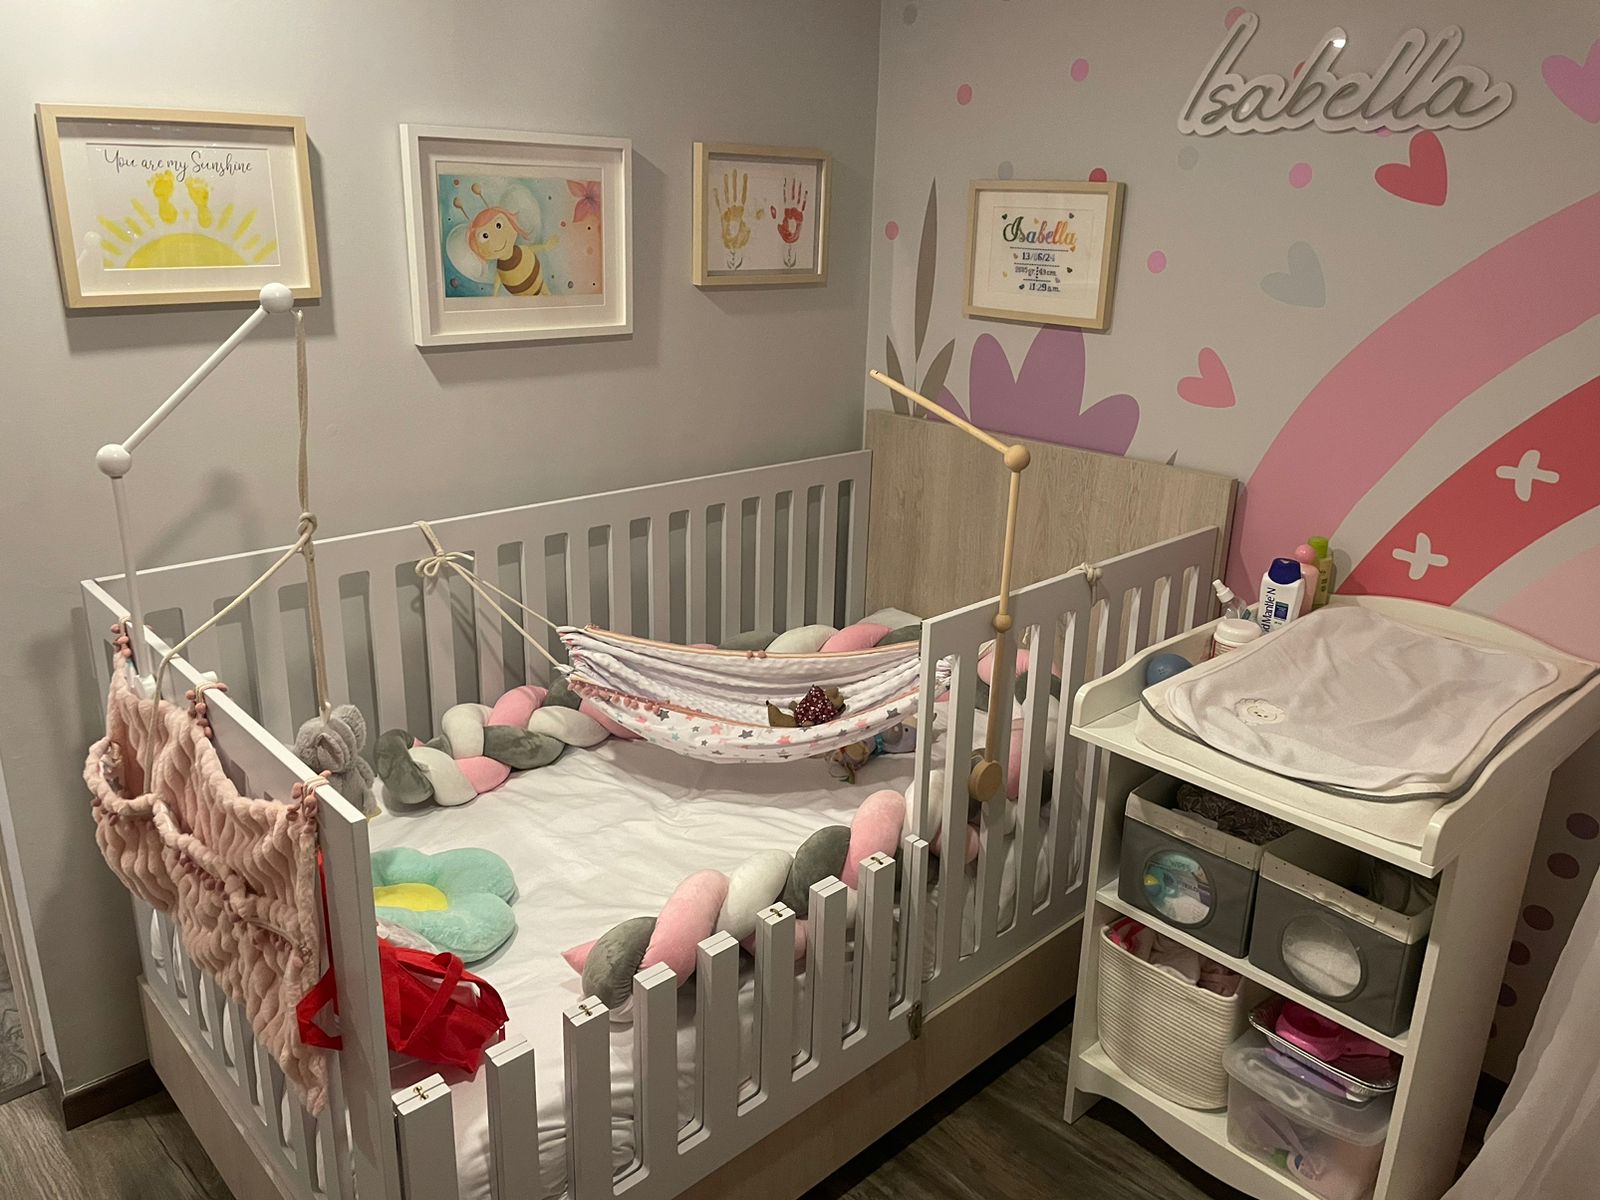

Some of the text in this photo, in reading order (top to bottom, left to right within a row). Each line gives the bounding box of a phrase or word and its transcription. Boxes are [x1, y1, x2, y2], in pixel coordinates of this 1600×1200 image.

[1181, 20, 1504, 128] Isabella
[104, 149, 252, 182] You are my Sunshine
[1003, 216, 1076, 245] Isabella
